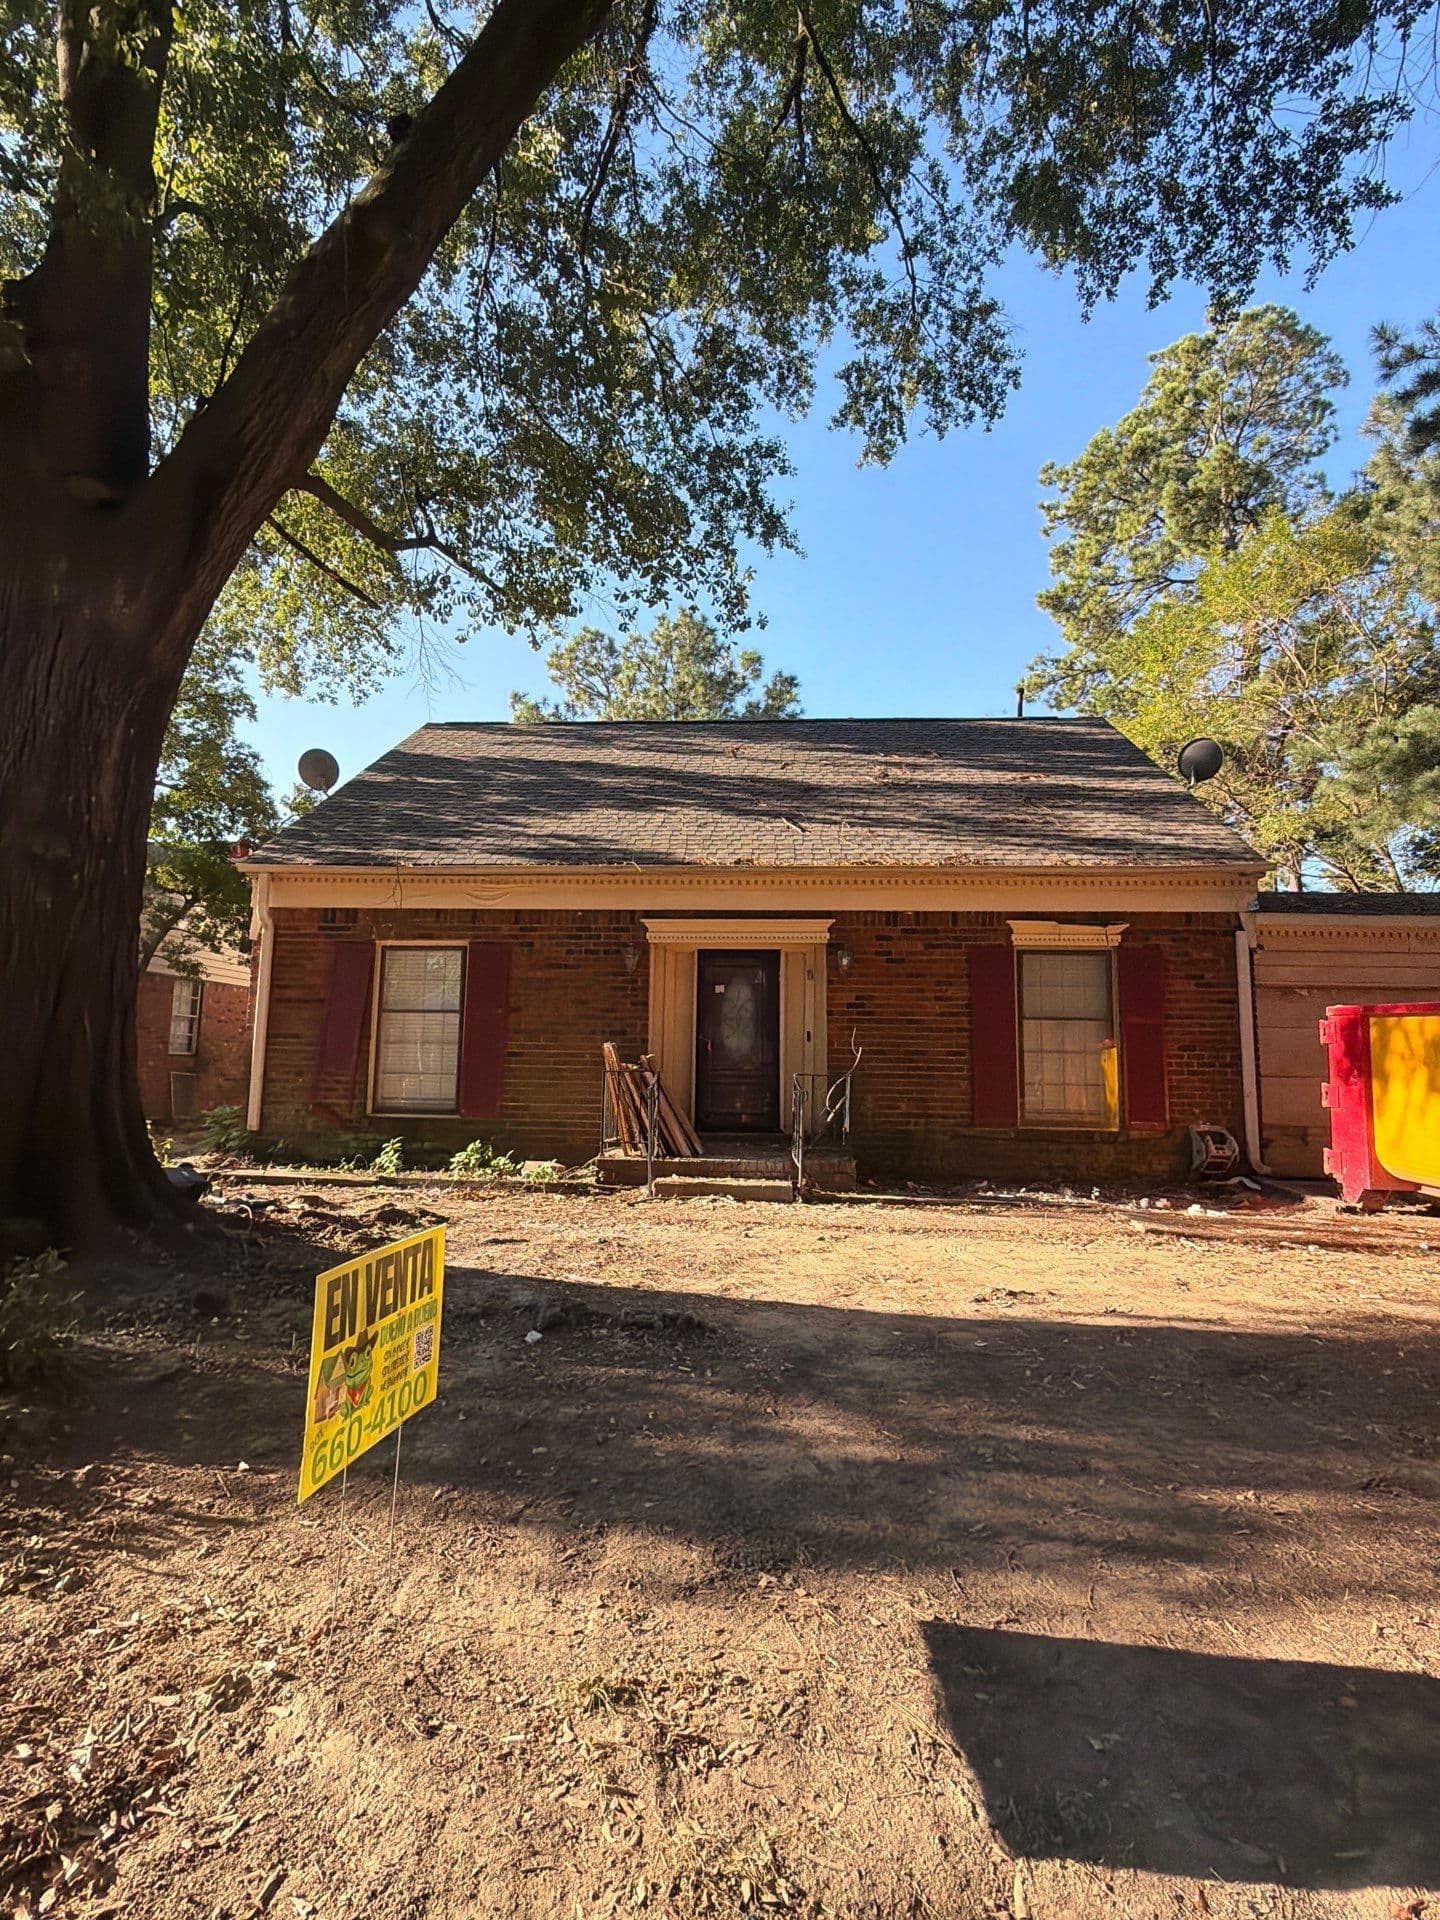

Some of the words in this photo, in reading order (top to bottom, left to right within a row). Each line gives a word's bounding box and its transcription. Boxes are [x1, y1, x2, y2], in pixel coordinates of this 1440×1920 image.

[324, 1268, 360, 1353] EN
[365, 1238, 434, 1328] VENTA
[310, 1371, 428, 1486] 660-4100
